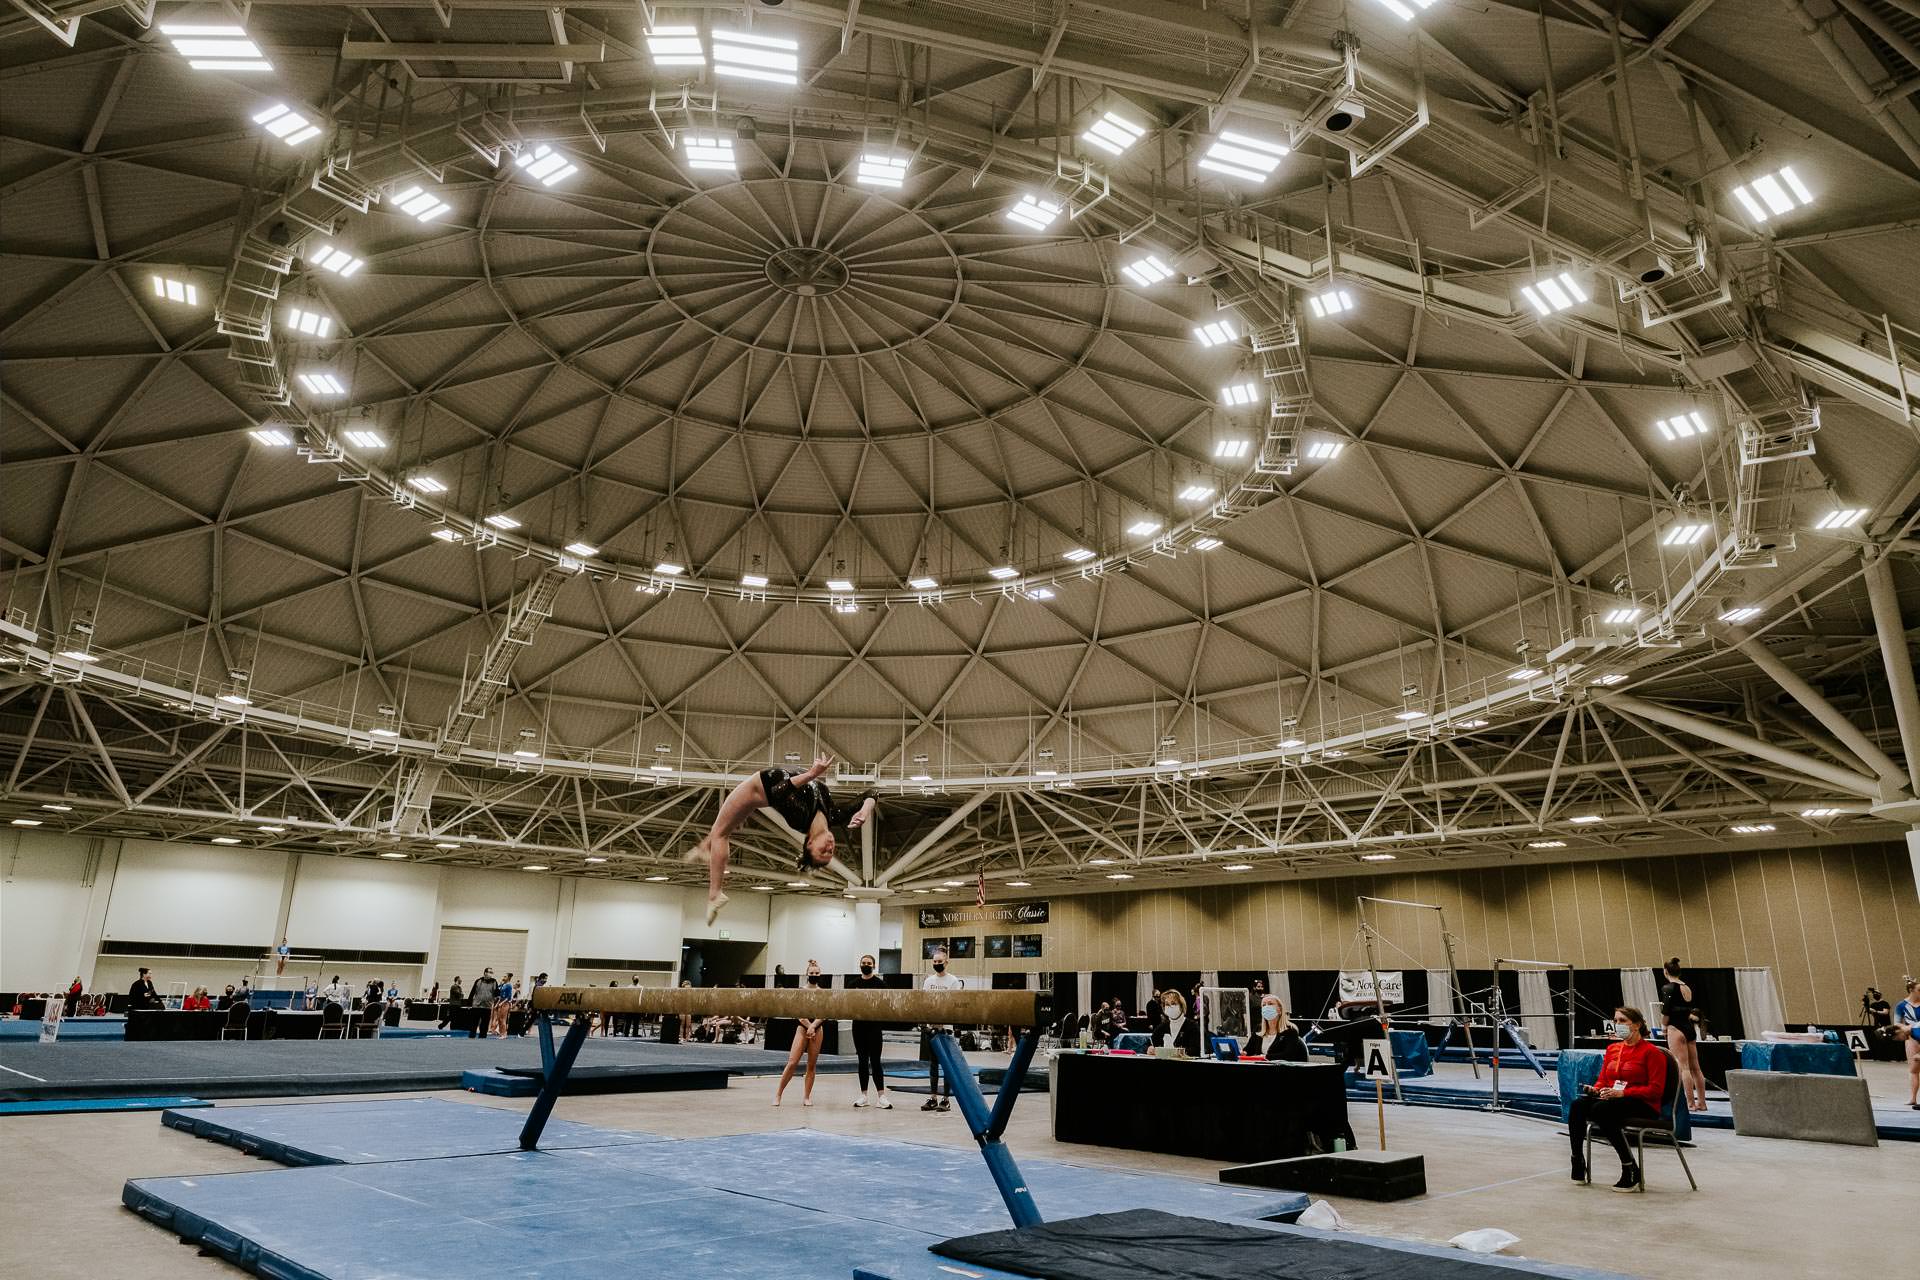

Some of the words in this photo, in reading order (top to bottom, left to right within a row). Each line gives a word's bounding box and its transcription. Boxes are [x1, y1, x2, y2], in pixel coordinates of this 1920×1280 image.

[943, 911, 984, 922] NORTHERN
[985, 909, 1013, 921] LIGHTS
[1014, 905, 1046, 922] Classic
[1605, 1023, 1614, 1031] A
[1851, 1036, 1866, 1050] A
[1367, 1049, 1389, 1075] A
